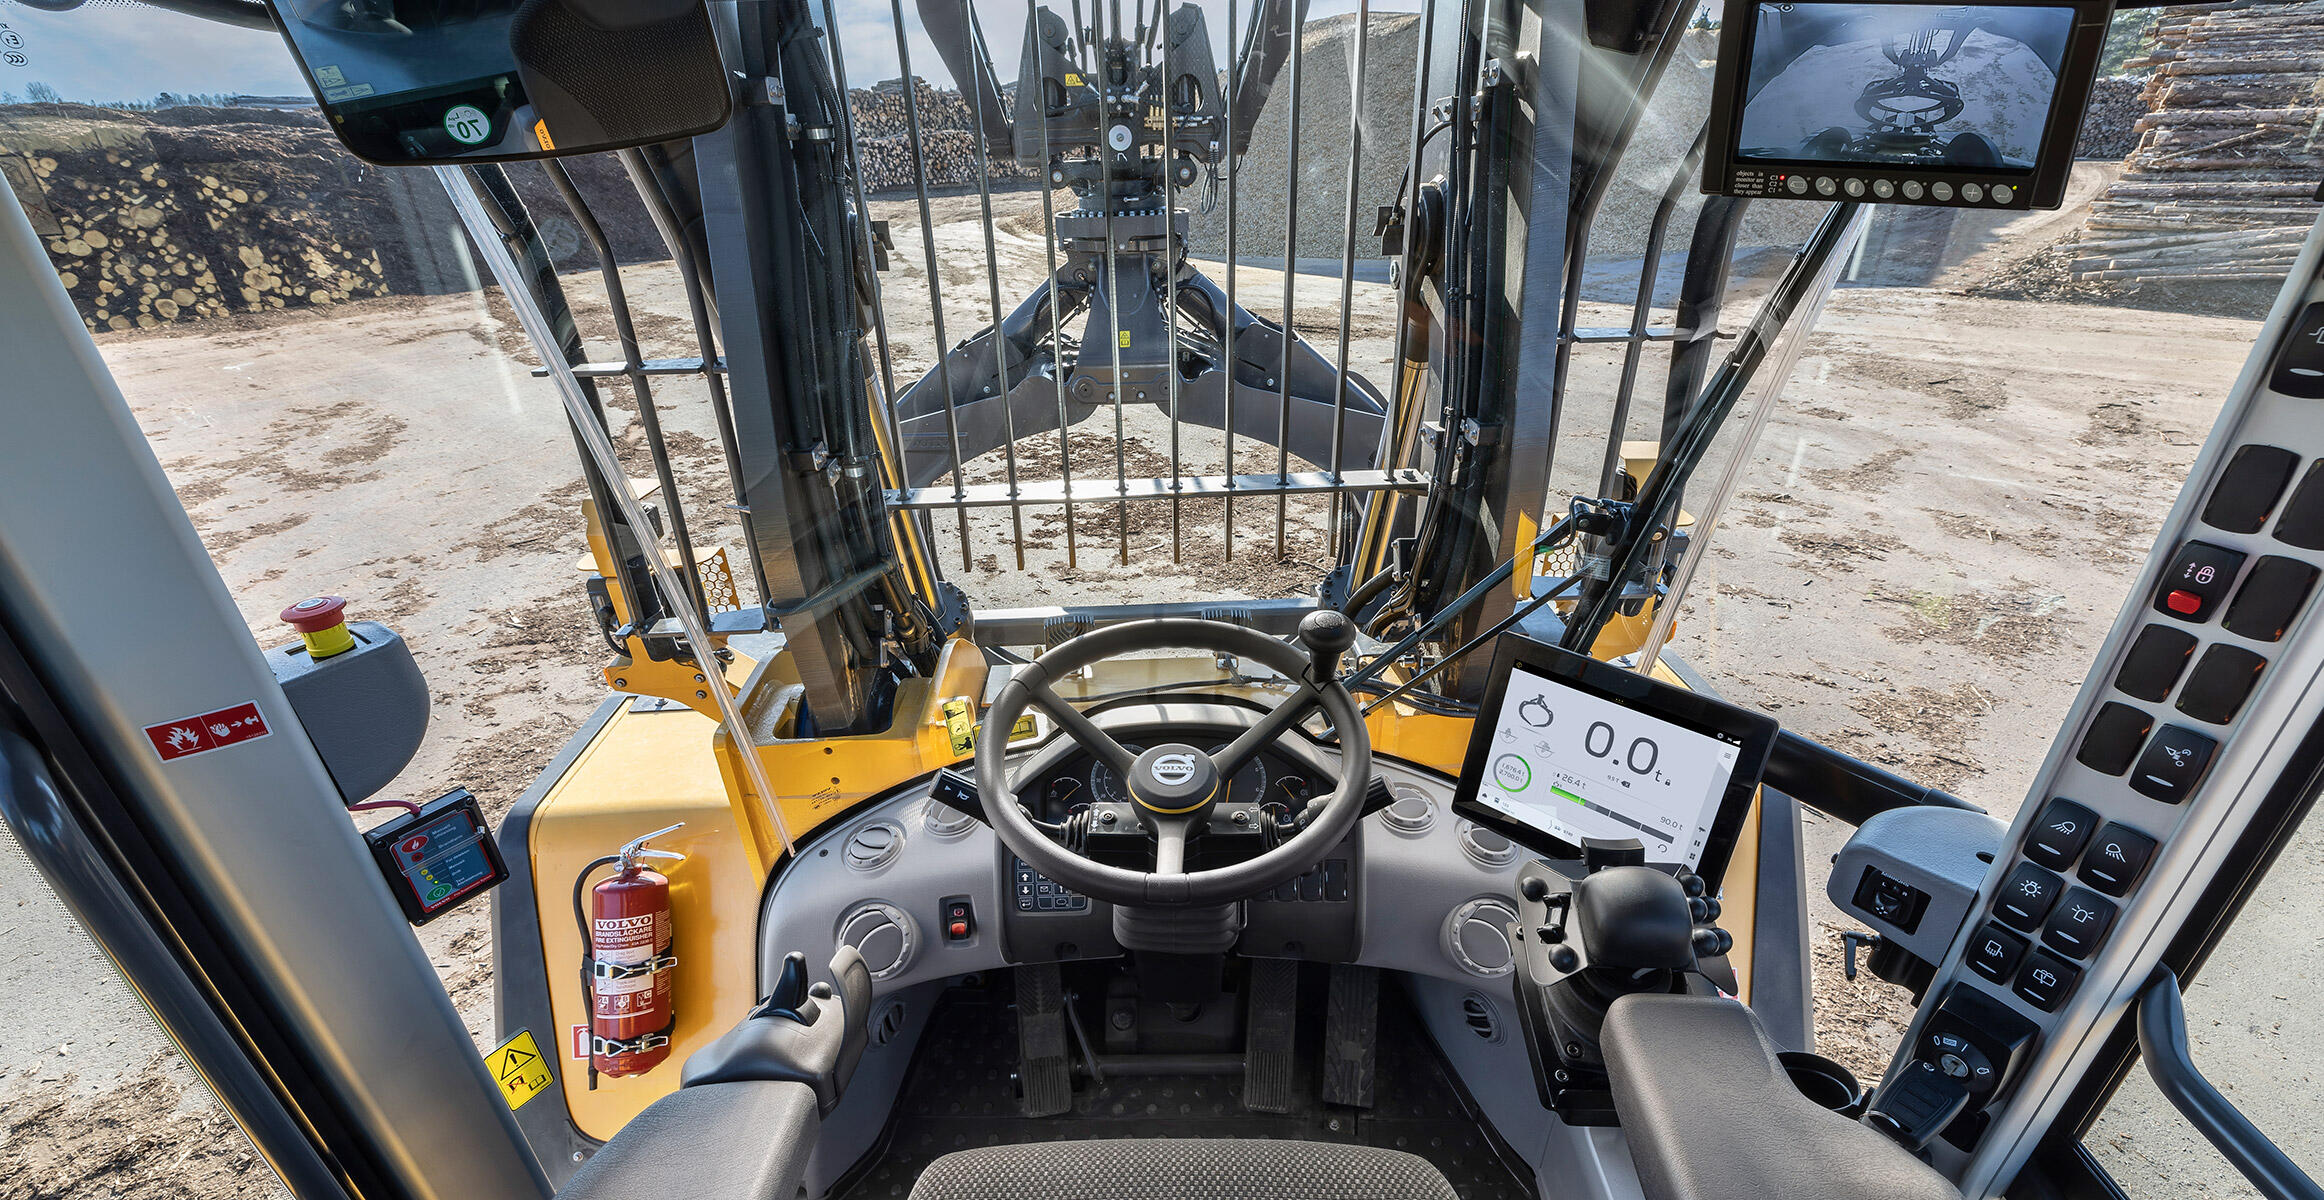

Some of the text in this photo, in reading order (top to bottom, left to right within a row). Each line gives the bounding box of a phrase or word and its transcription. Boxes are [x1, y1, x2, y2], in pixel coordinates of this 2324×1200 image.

[1585, 720, 1663, 783] 0.0 t
[1562, 773, 1581, 788] 26.4
[1660, 816, 1679, 830] 90.0
[597, 916, 652, 929] VOLVO
[606, 932, 653, 944] EXTINGUISHER
